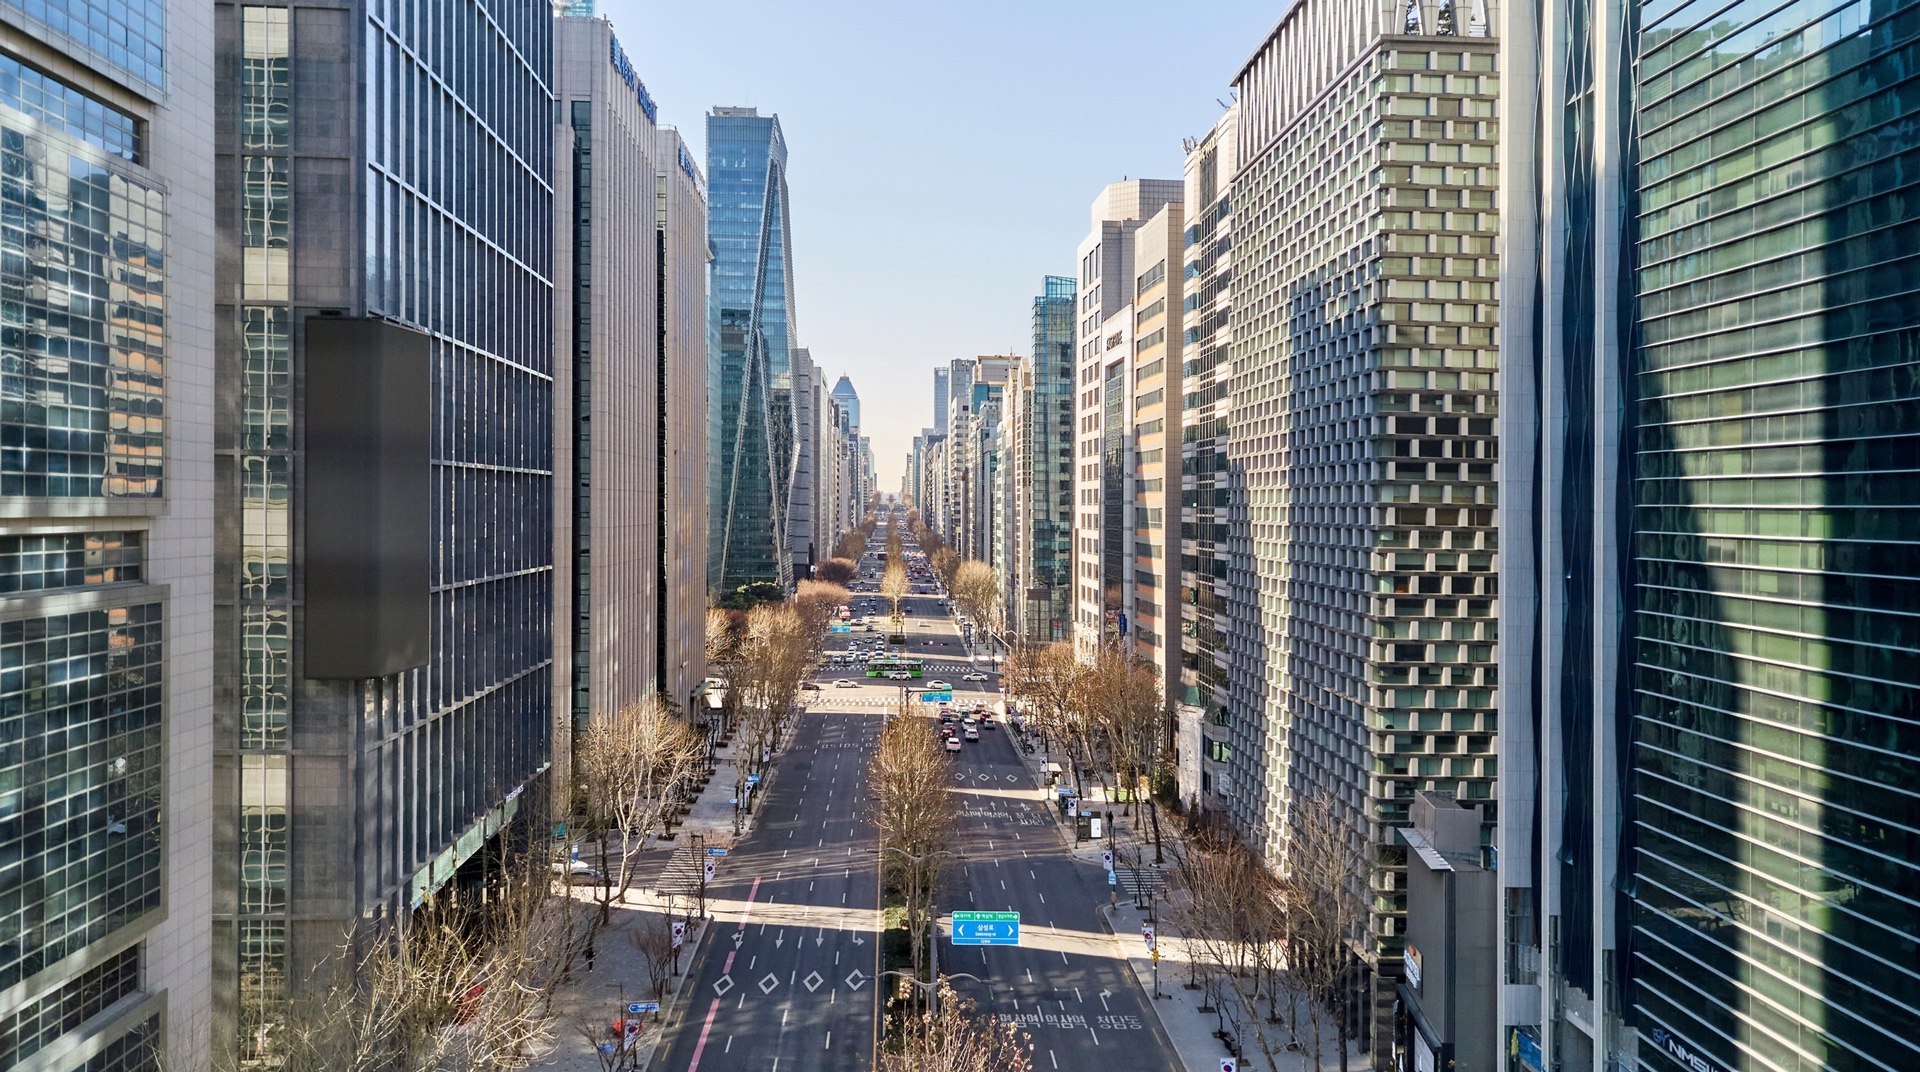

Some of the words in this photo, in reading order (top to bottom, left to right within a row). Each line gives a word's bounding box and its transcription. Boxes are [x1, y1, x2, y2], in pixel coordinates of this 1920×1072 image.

[977, 924, 994, 932] 삼성로
[1045, 1014, 1088, 1029] 역삼역
[1096, 1015, 1143, 1030] 청담동
